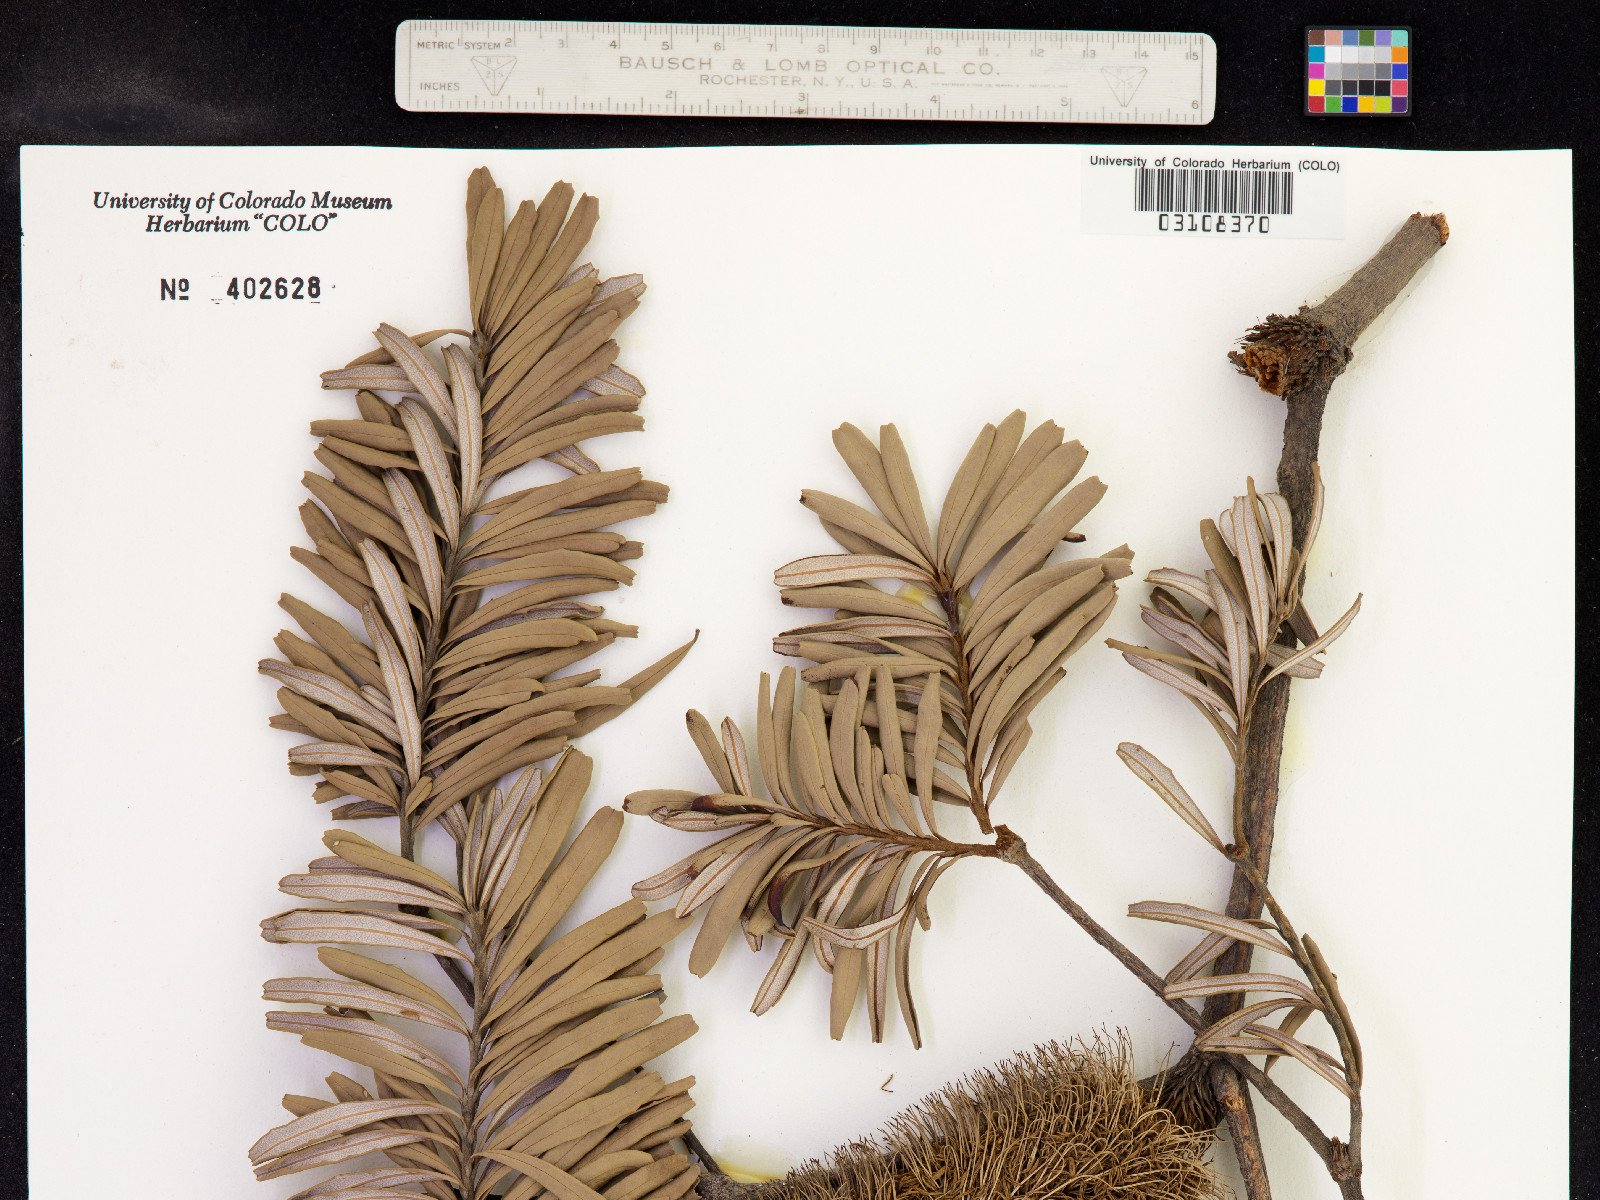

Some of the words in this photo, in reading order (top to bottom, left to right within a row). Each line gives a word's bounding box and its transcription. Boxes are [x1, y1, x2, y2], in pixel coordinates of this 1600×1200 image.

[417, 41, 454, 49] METRIC
[464, 41, 501, 50] SYSTEM
[504, 37, 512, 47] 2
[559, 39, 565, 48] 3
[609, 40, 617, 49] 4
[661, 41, 670, 50] 5
[714, 42, 722, 51] 6
[767, 43, 774, 52] 7
[870, 45, 878, 54] 9
[619, 56, 711, 70] BAUSCH
[732, 58, 745, 71] &
[765, 58, 827, 72] LOMB
[846, 60, 945, 74] OPTICAL
[963, 62, 1000, 76] CO.
[420, 82, 460, 91] INCHES
[665, 90, 673, 99] 2
[798, 92, 806, 101] 3
[930, 95, 938, 103] 4
[1192, 100, 1199, 109] 6
[1090, 155, 1148, 171] University
[1152, 156, 1168, 169] of
[1171, 156, 1226, 170] Colorado
[1230, 158, 1292, 172] Herbarium
[1298, 159, 1340, 174] (COLO)
[93, 190, 192, 215] University
[195, 191, 216, 215] of
[217, 189, 307, 210] Colorado
[310, 190, 393, 212] Museum
[145, 213, 251, 233] Herbarium
[1157, 213, 1271, 234] 03108370
[226, 275, 321, 301] 402628
